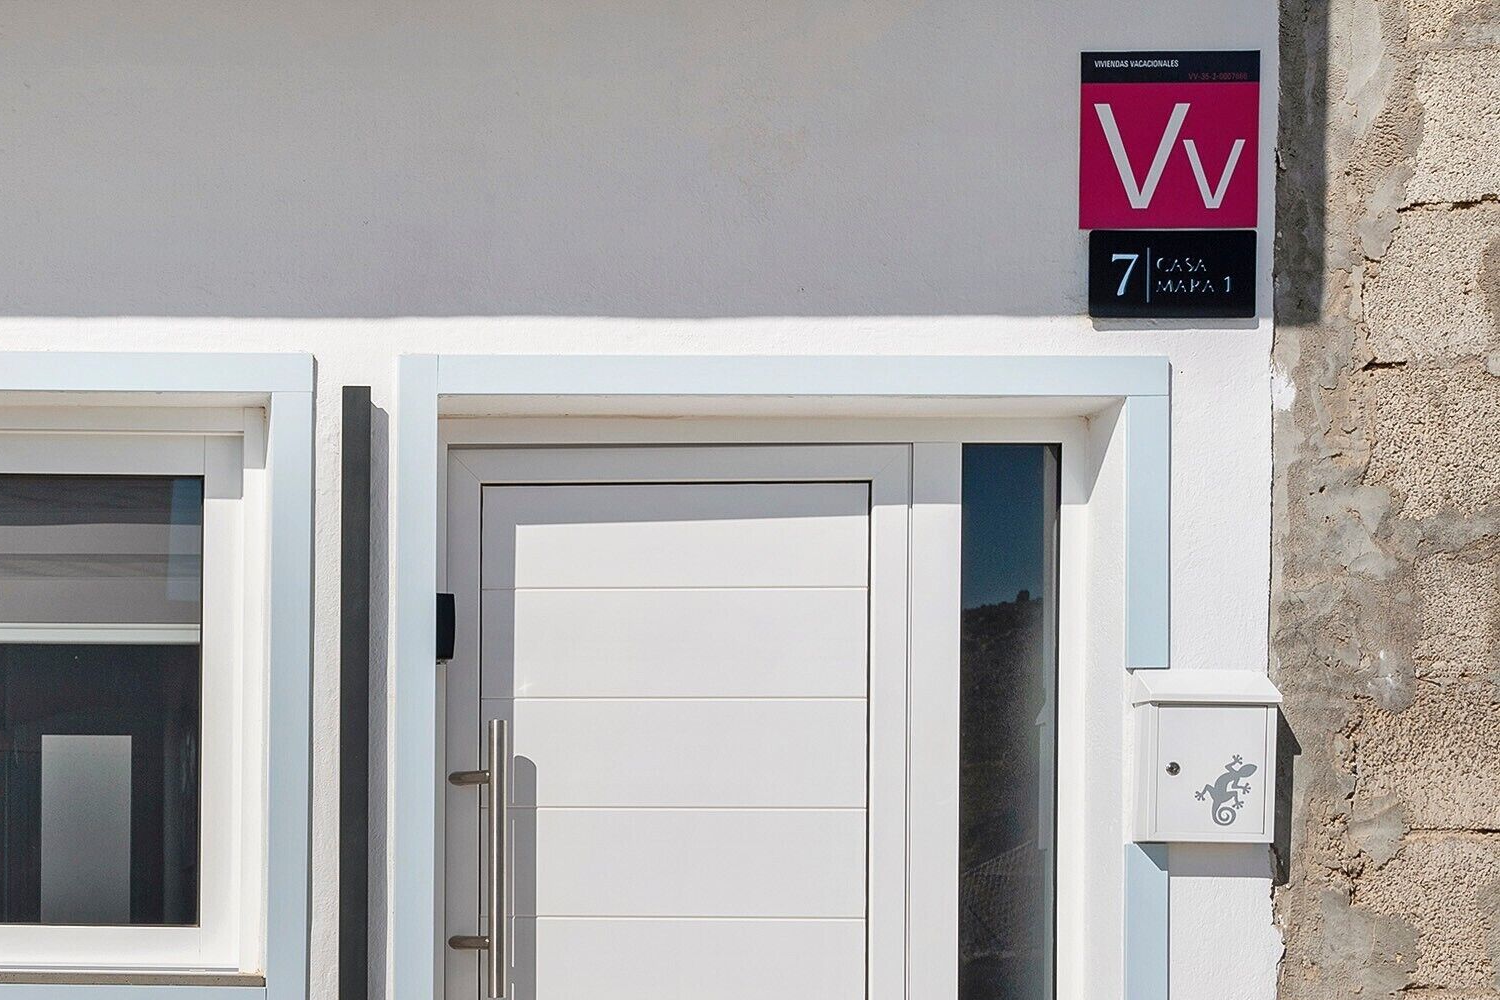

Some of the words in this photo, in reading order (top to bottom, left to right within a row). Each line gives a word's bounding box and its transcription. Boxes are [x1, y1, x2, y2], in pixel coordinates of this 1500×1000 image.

[1094, 59, 1129, 68] VIVIENDAS
[1130, 59, 1179, 68] VACACIONALES
[1156, 257, 1207, 272] CASA
[1111, 253, 1139, 296] 7
[1223, 275, 1233, 293] 1
